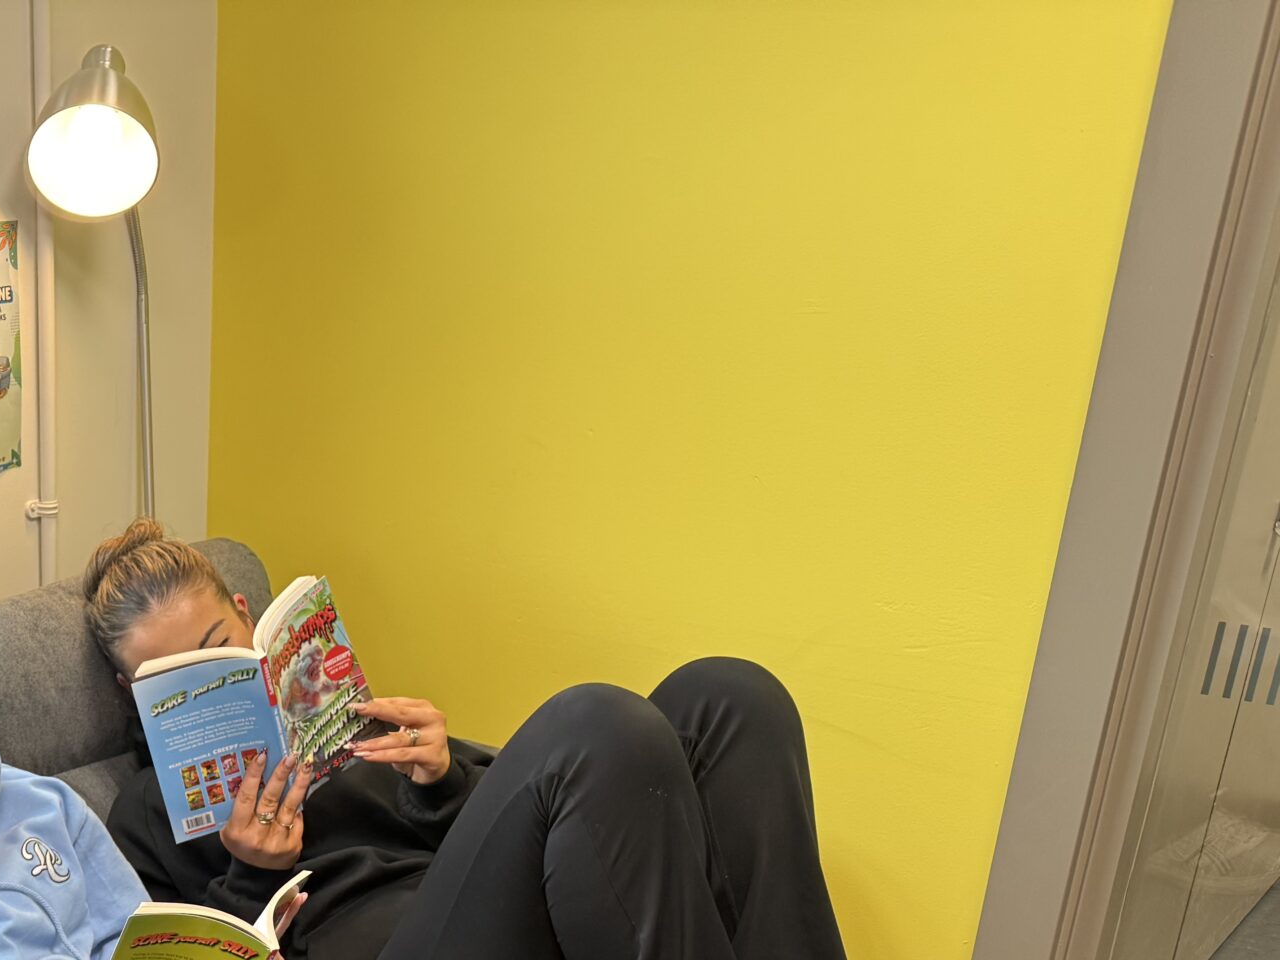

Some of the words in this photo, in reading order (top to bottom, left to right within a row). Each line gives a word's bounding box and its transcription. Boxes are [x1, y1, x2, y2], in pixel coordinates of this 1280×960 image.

[150, 690, 187, 717] SCARE
[191, 676, 225, 700] yourself
[226, 667, 258, 684] SILLY
[130, 932, 178, 949] SCARE
[174, 935, 221, 947] yourself
[219, 940, 259, 960] SILLY
